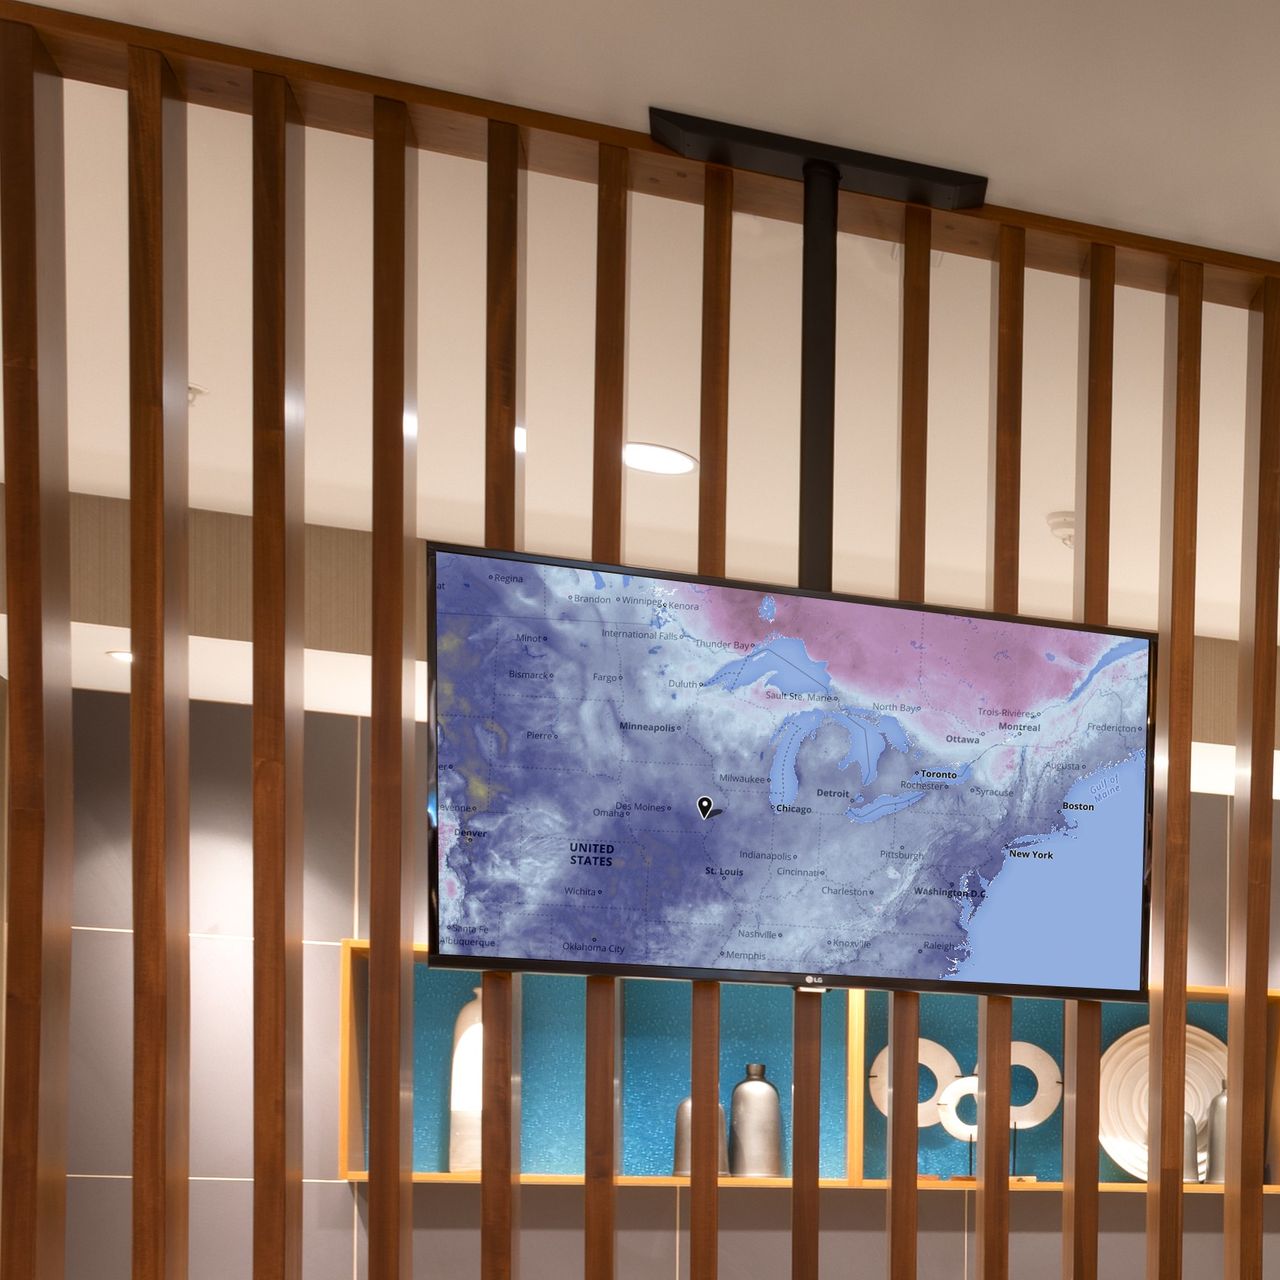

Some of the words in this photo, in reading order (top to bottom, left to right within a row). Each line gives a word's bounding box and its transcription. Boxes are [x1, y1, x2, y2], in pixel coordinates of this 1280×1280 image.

[494, 574, 524, 584] Regina
[574, 594, 611, 603] Brandon
[622, 596, 662, 607] Winnipeg
[668, 601, 699, 611] Kenora
[516, 634, 542, 643] Minot
[602, 629, 657, 640] International
[659, 632, 677, 641] Falls
[696, 639, 731, 649] Thunder
[733, 641, 750, 652] Bay
[509, 670, 548, 680] Bismarck
[593, 673, 617, 683] Fargo
[668, 679, 698, 689] Duluth
[766, 691, 786, 700] Sault
[872, 702, 897, 711] North
[900, 704, 916, 713] Bay
[619, 721, 676, 733] Minneapolis
[998, 722, 1041, 732] Montreal
[1087, 723, 1136, 733] Fredericton
[526, 731, 552, 740] Pierre
[946, 735, 980, 744] Ottawa
[1045, 761, 1080, 772] Augusta
[719, 774, 765, 784] Milwaukee
[921, 769, 957, 779] Toronto
[901, 781, 944, 791] Rochester
[817, 788, 849, 798] Detroit
[976, 788, 1014, 798] Syracuse
[1094, 785, 1120, 803] Maine
[616, 802, 632, 810] Des
[634, 803, 665, 812] Moines
[776, 804, 812, 815] Chicago
[1062, 801, 1095, 811] Boston
[593, 808, 624, 818] Omaha
[454, 829, 487, 838] Denver
[570, 843, 614, 854] UNITED
[739, 851, 792, 861] Indianapolis
[880, 850, 924, 862] Pittsburgh
[1009, 849, 1030, 858] New
[1032, 851, 1054, 860] York
[570, 855, 612, 867] STATES
[705, 867, 717, 875] St.
[720, 868, 744, 877] Louis
[777, 867, 819, 877] Cincinnati
[564, 887, 596, 896] Wichita
[821, 886, 868, 896] Charleston
[914, 887, 968, 898] Washington
[452, 924, 477, 934] Santa
[479, 926, 489, 934] Fe
[738, 930, 776, 939] Nashville
[440, 937, 495, 949] Albuquerque
[562, 942, 606, 952] Oklahoma
[608, 944, 625, 953] City
[833, 940, 871, 949] Knoxville
[923, 941, 955, 952] Raleigh
[726, 951, 766, 961] Memphis
